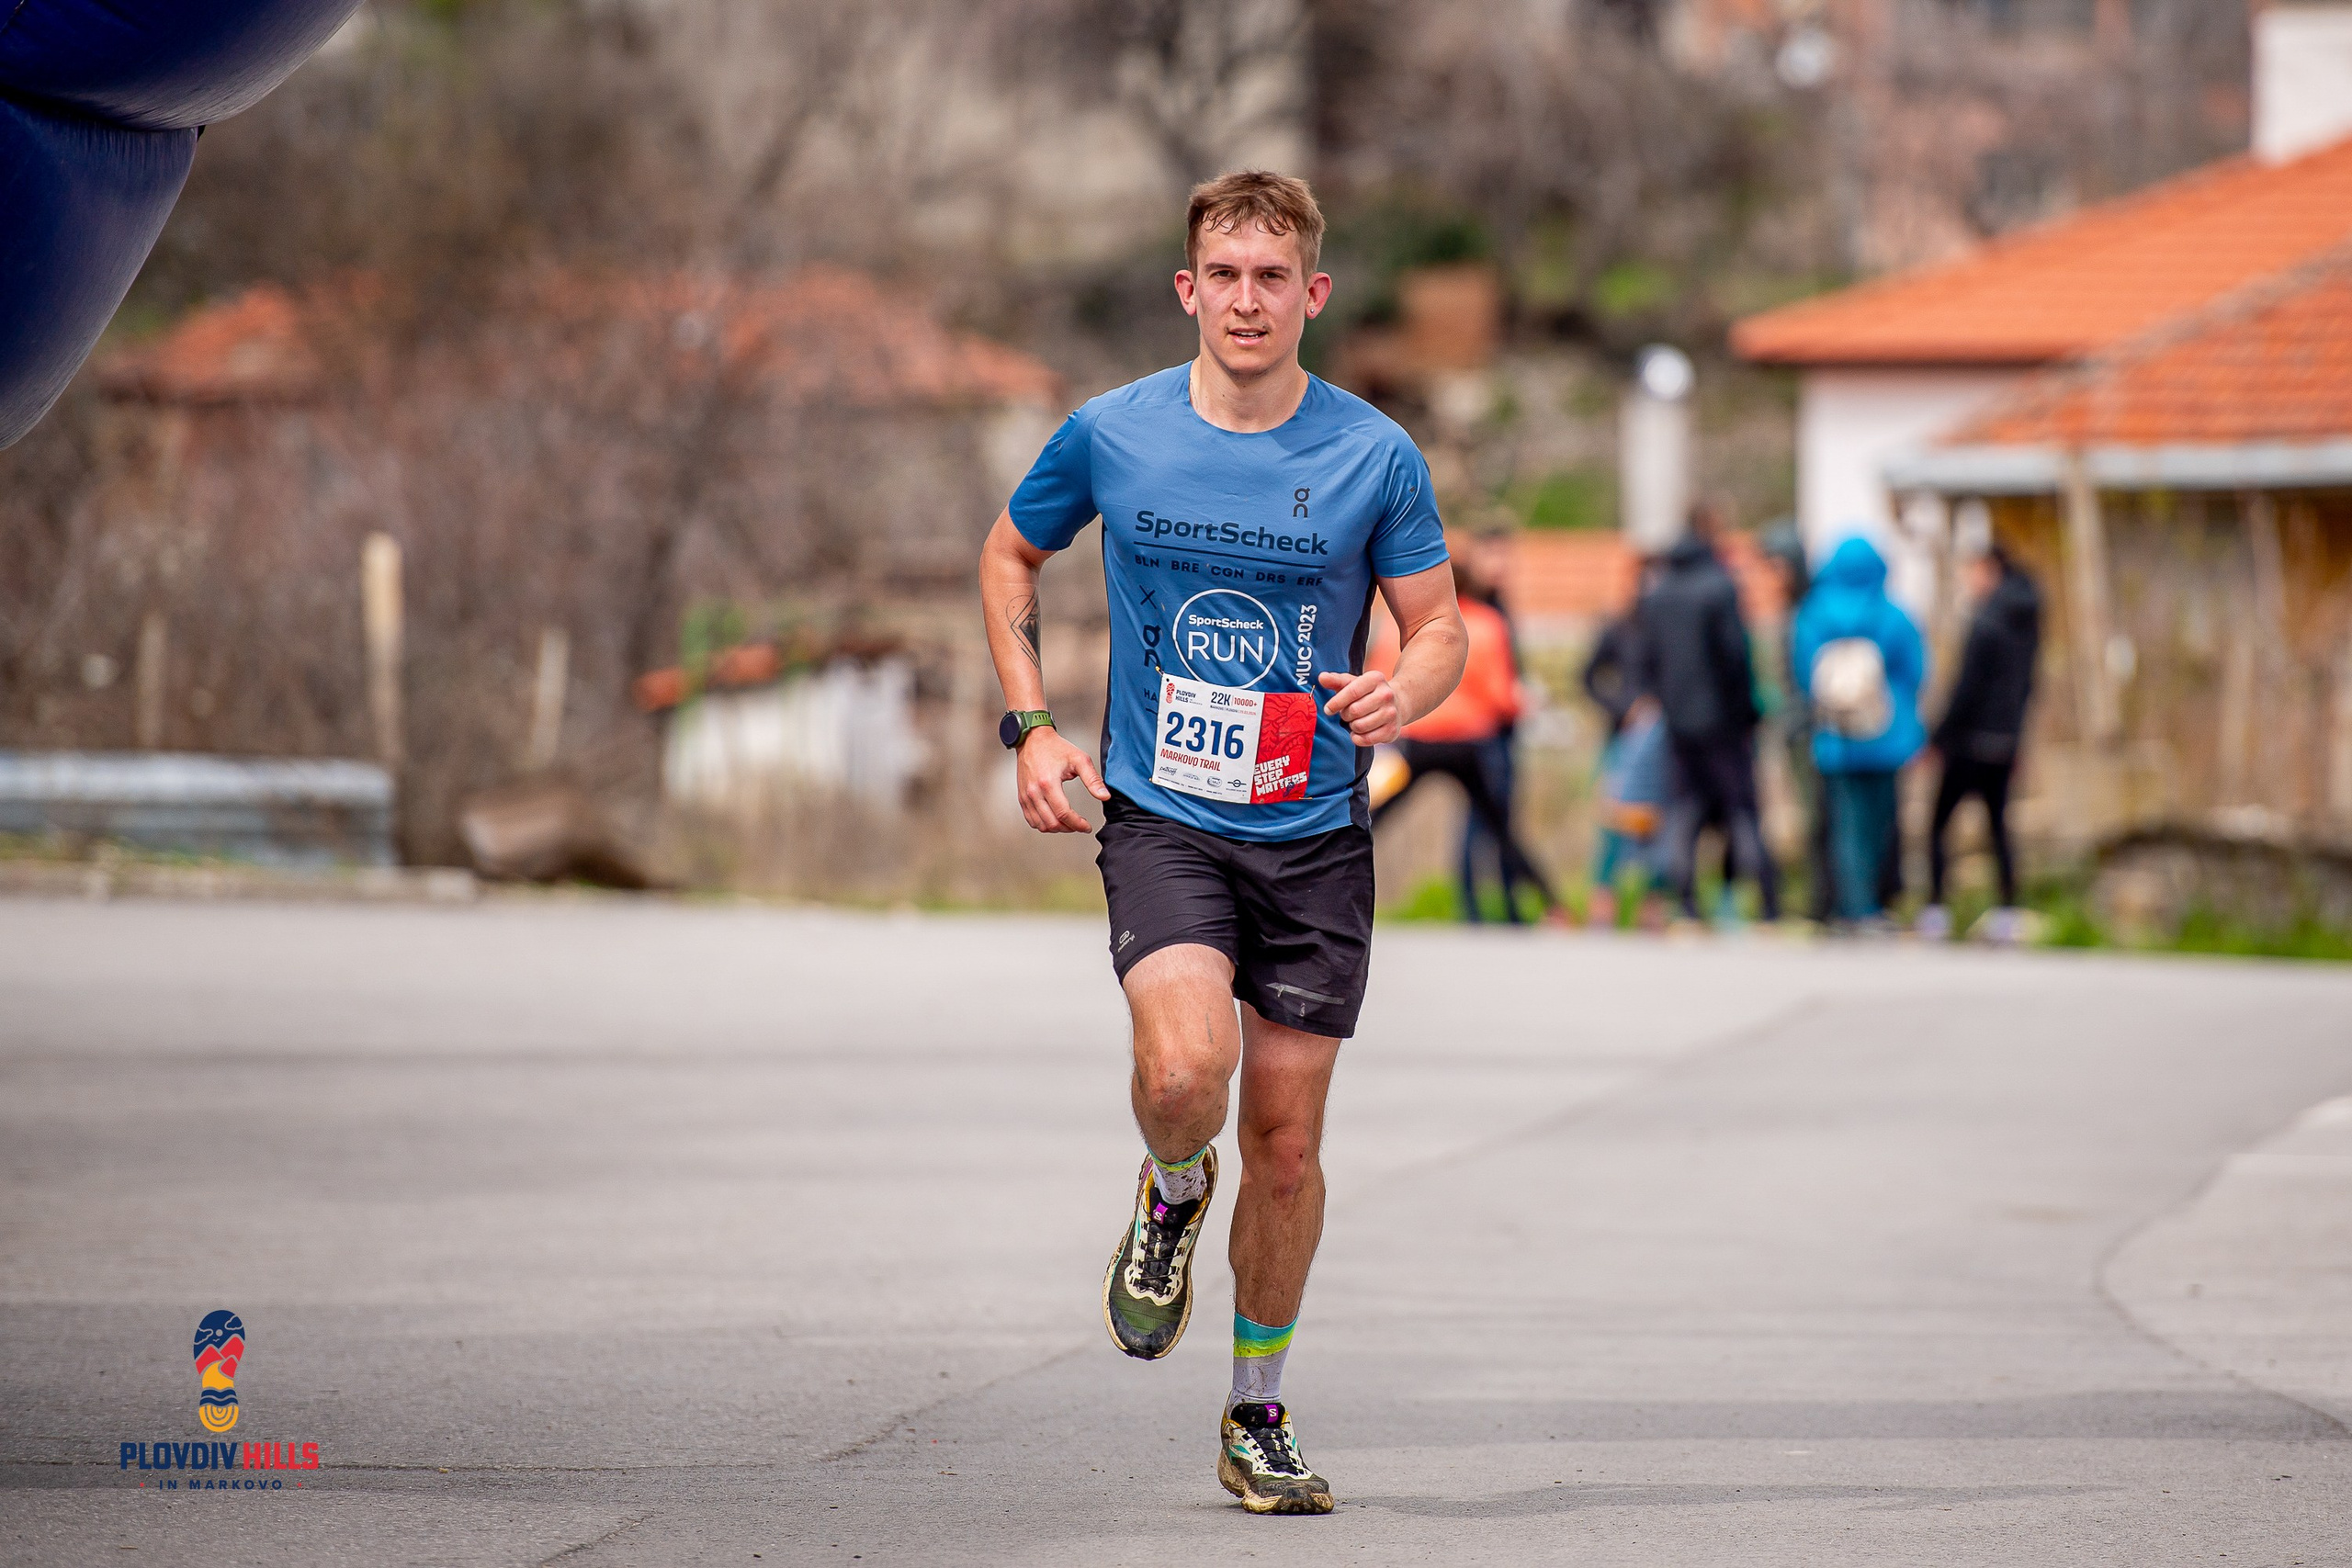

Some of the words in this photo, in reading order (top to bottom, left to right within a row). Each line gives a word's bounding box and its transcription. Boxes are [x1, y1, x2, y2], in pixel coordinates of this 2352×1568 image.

[1135, 510, 1329, 556] SportScheck
[1135, 554, 1159, 570] BLN
[1170, 560, 1200, 573] BRE
[1210, 565, 1244, 579] CGN
[1256, 571, 1286, 584] DRS
[1296, 576, 1324, 587] ERF
[1188, 614, 1264, 630] SportScheck
[1297, 604, 1318, 645] 2023
[1187, 631, 1265, 665] RUN
[1295, 645, 1314, 686] MUC
[1144, 687, 1159, 703] HA
[1211, 692, 1231, 705] 22K
[1234, 697, 1258, 706] 1000D+
[1164, 711, 1245, 760] 2316
[1159, 748, 1199, 767] MARKOVO
[1200, 758, 1221, 772] TRAIL
[1254, 755, 1290, 774] EVERY
[1253, 768, 1284, 786] STEP
[1255, 771, 1308, 796] MATTERS
